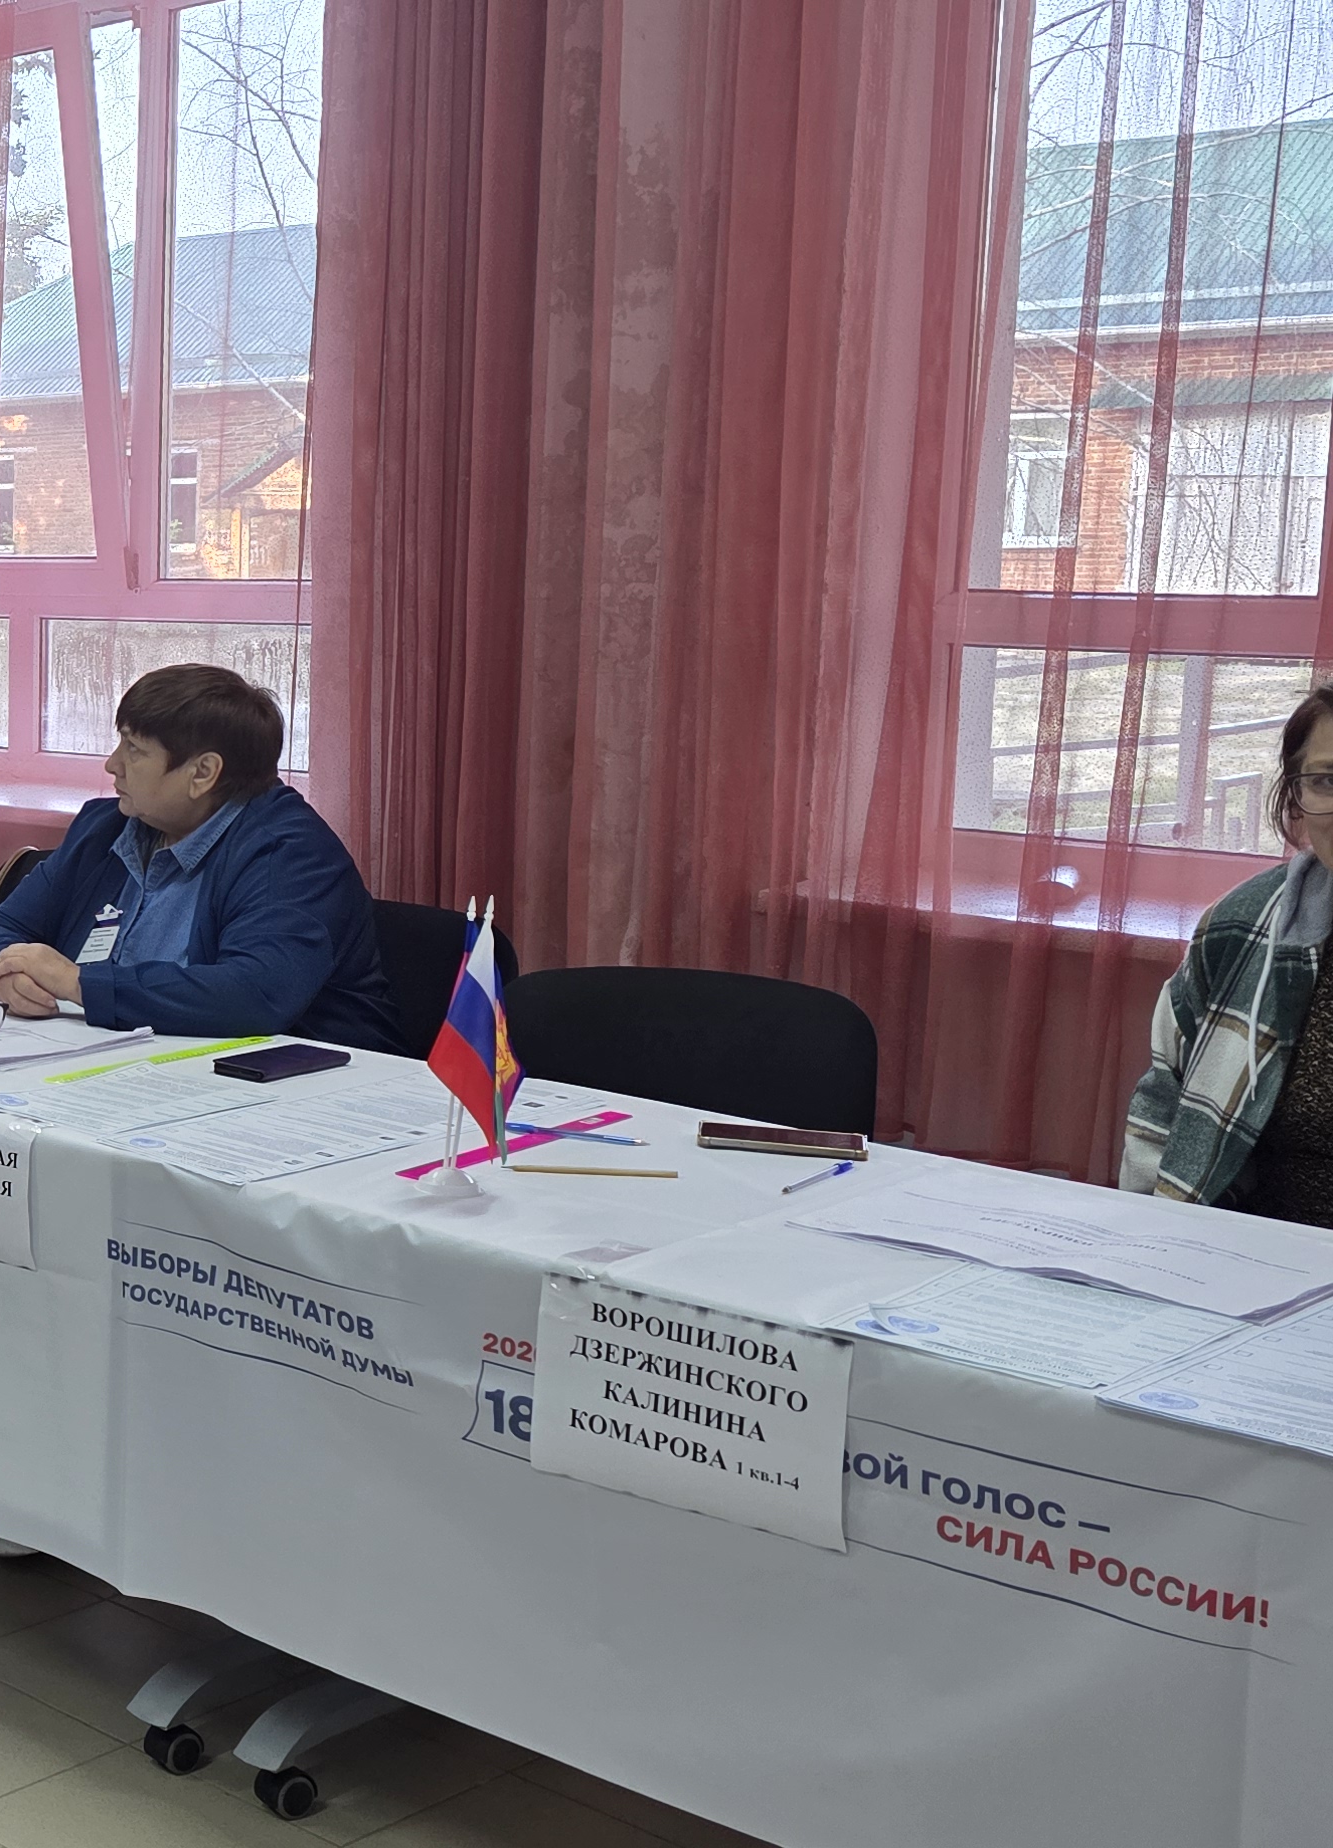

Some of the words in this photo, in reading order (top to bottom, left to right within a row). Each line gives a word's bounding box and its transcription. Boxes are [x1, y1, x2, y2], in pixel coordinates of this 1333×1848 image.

[107, 1238, 217, 1287] ВЫБОРЫ
[223, 1269, 375, 1340] ДЕПУТАТОВ
[121, 1281, 336, 1361] ГОСУДАРСТВЕННОЙ
[341, 1348, 415, 1387] ДУМЫ
[482, 1332, 536, 1364] 202
[591, 1301, 799, 1373] ВОРОШИЛОВА
[569, 1335, 809, 1414] ДЗЕРЖИНСКОГО
[603, 1379, 767, 1444] КАЛИНИНА
[484, 1388, 533, 1442] 18
[569, 1407, 728, 1472] КОМАРОВА
[735, 1460, 744, 1476] 1
[749, 1467, 800, 1491] кв.1-4
[921, 1469, 1066, 1529] ГОЛОС
[936, 1514, 1056, 1570] СИЛА
[1068, 1548, 1270, 1629] РОССИИ!
